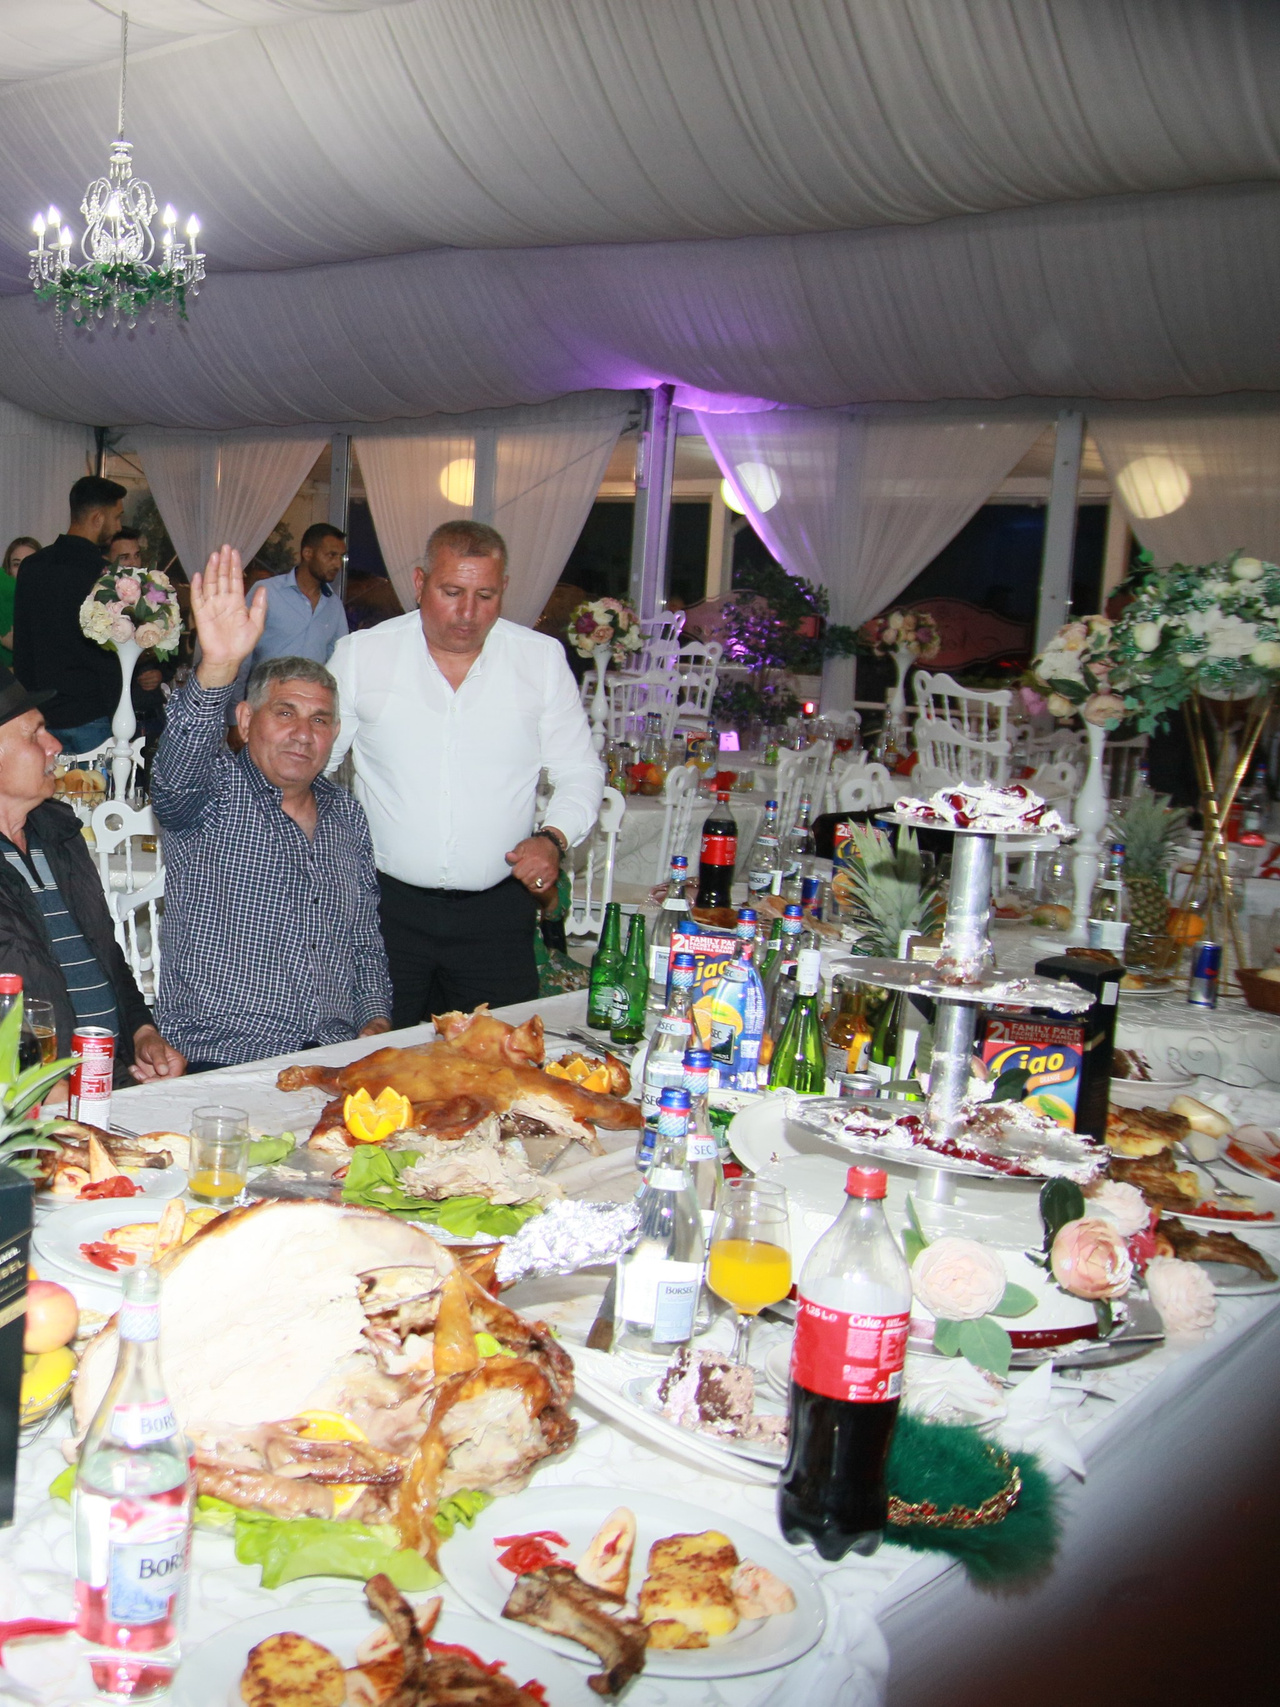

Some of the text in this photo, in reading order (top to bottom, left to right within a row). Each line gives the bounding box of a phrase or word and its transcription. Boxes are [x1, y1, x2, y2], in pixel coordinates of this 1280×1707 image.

[672, 933, 736, 953] 2L FAMILY PAC
[724, 967, 733, 978] SEC
[659, 1021, 675, 1032] SEC
[711, 1028, 723, 1039] SEC
[988, 1021, 1081, 1044] 2L FAMILY PACK
[1011, 1030, 1039, 1038] PACHET
[990, 1046, 1064, 1077] Ciao
[1040, 1073, 1061, 1084] ORANGE
[642, 1095, 660, 1106] SEC
[693, 1144, 713, 1155] SEC
[665, 1285, 694, 1295] BORSEC
[141, 1411, 176, 1435] BORS
[139, 1548, 185, 1579] BORS
